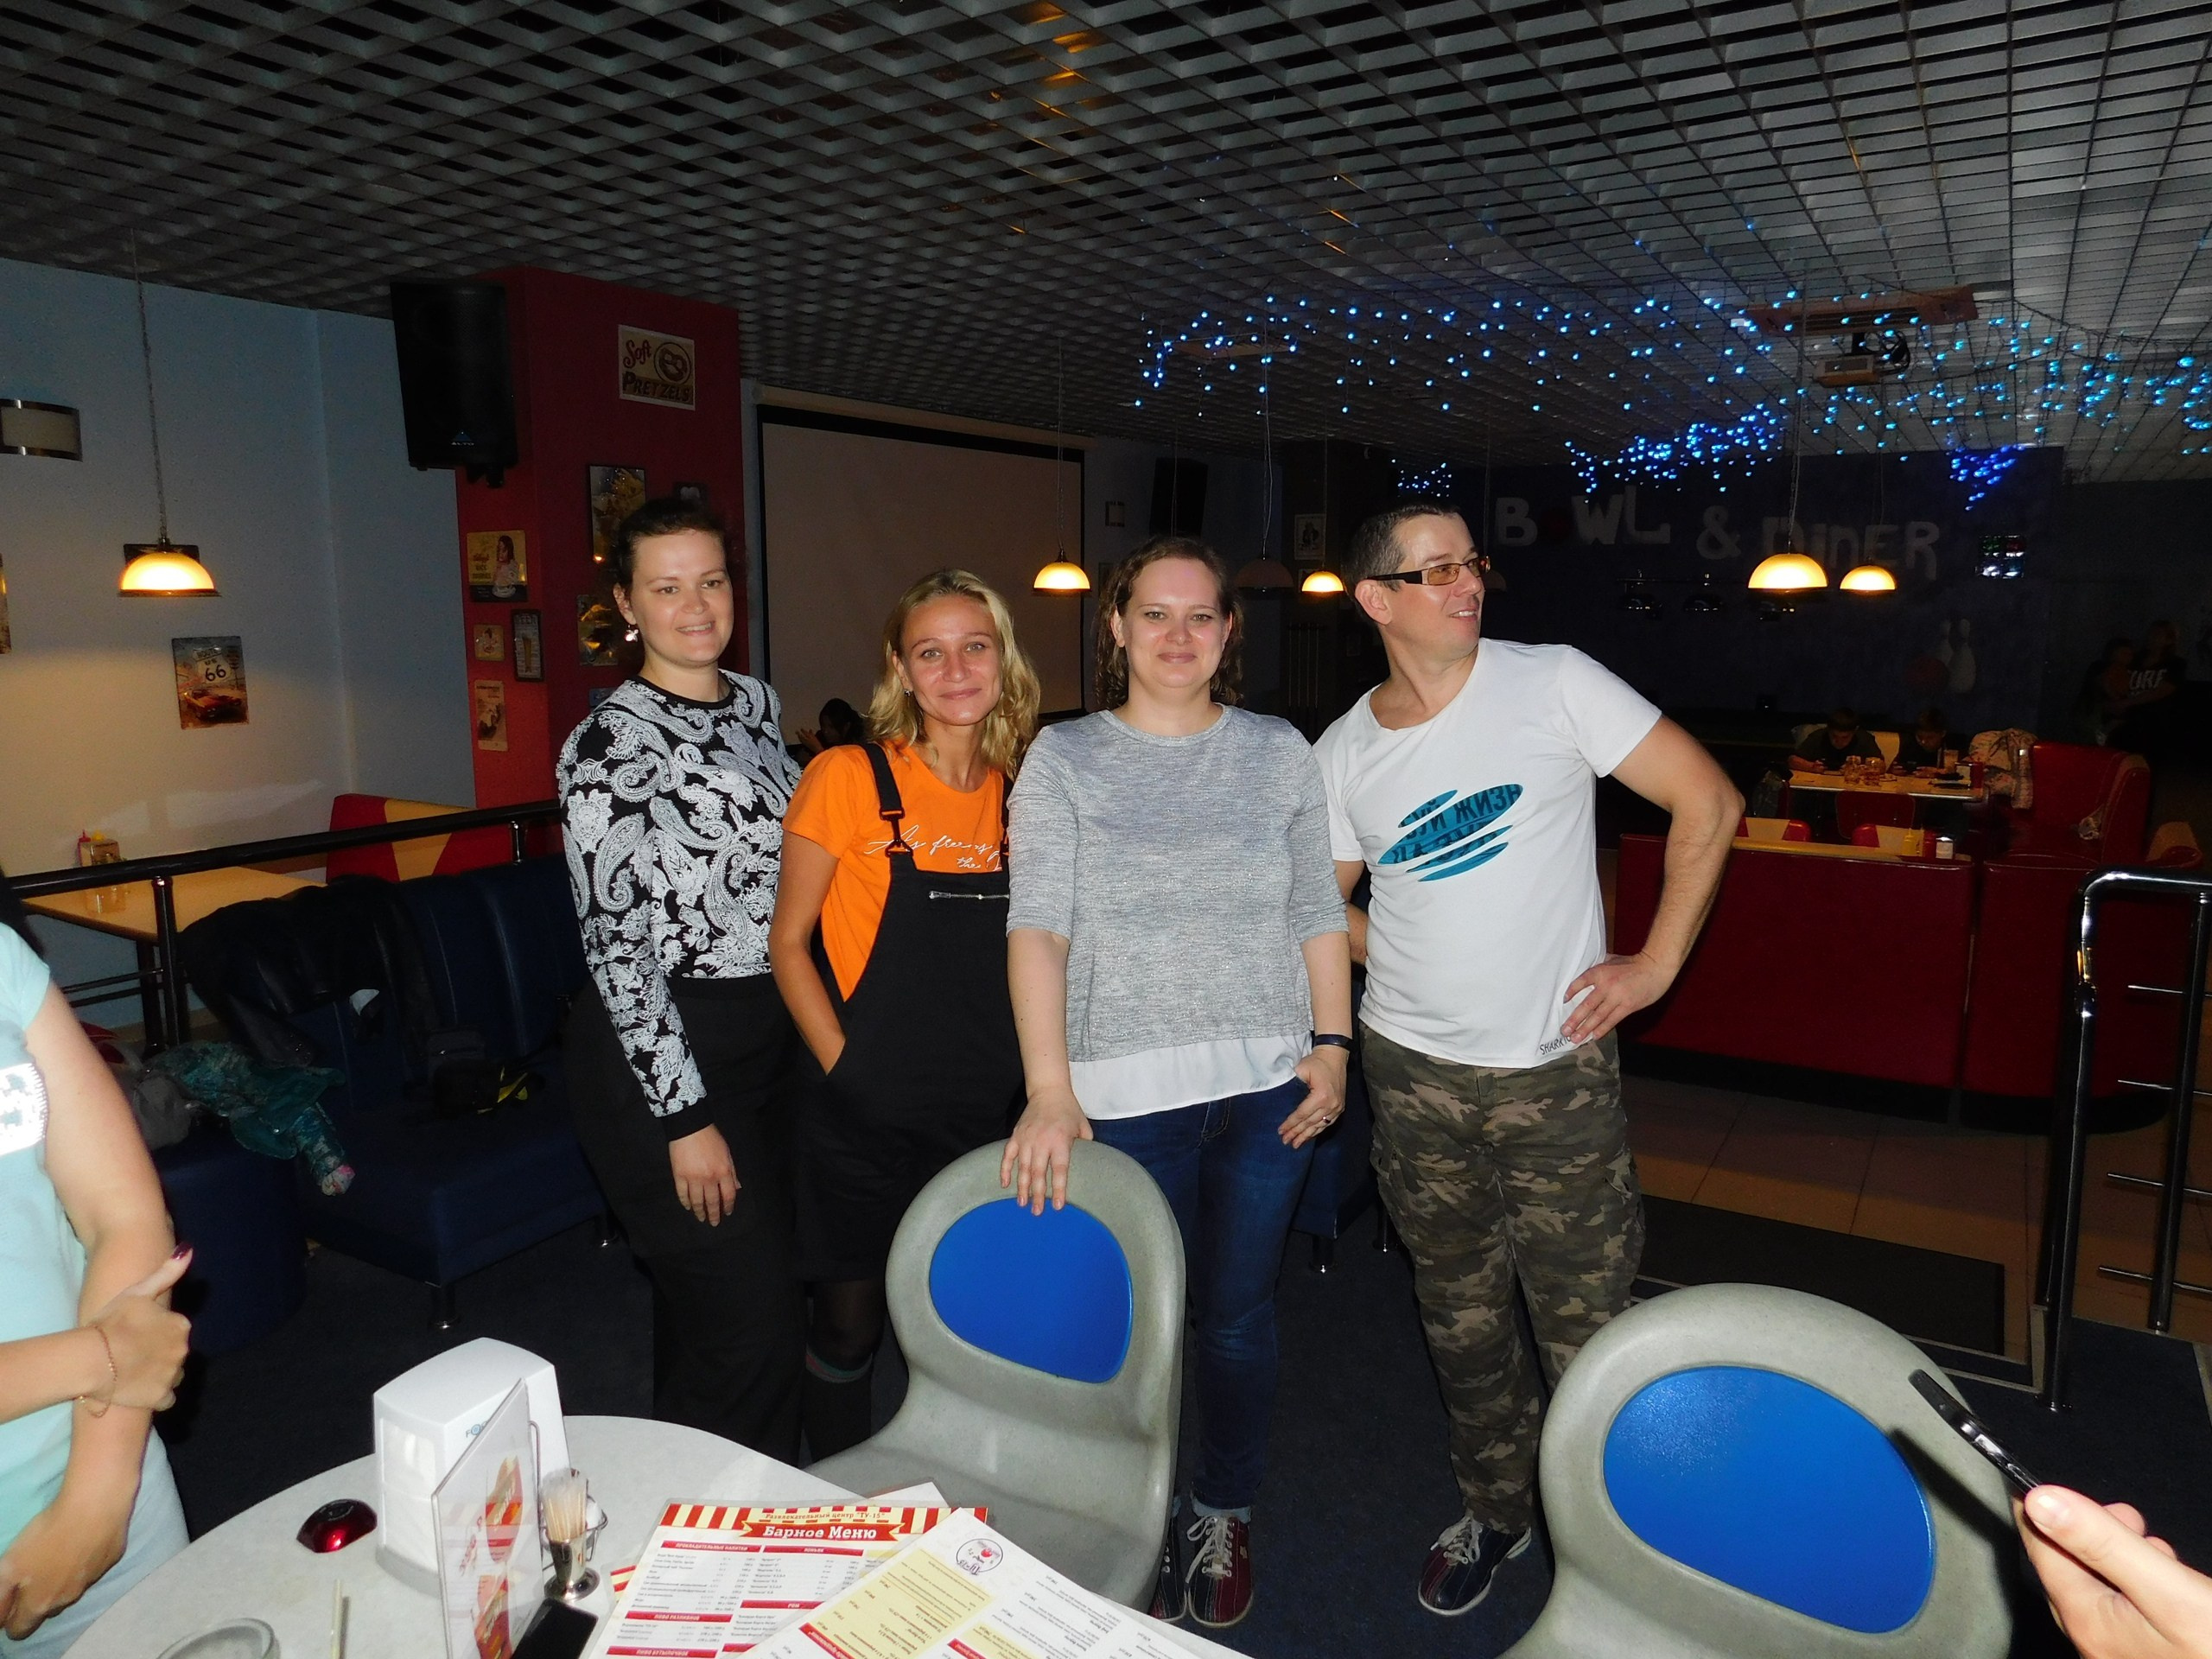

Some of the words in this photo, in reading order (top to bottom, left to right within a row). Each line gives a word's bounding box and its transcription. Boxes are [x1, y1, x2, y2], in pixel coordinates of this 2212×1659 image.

[622, 339, 652, 369] Soft
[622, 371, 690, 402] PRETZELS
[1694, 505, 1742, 560] &
[205, 664, 226, 682] 66
[2126, 668, 2168, 690] URF
[762, 1525, 824, 1540] Барное
[828, 1525, 877, 1541] Меню
